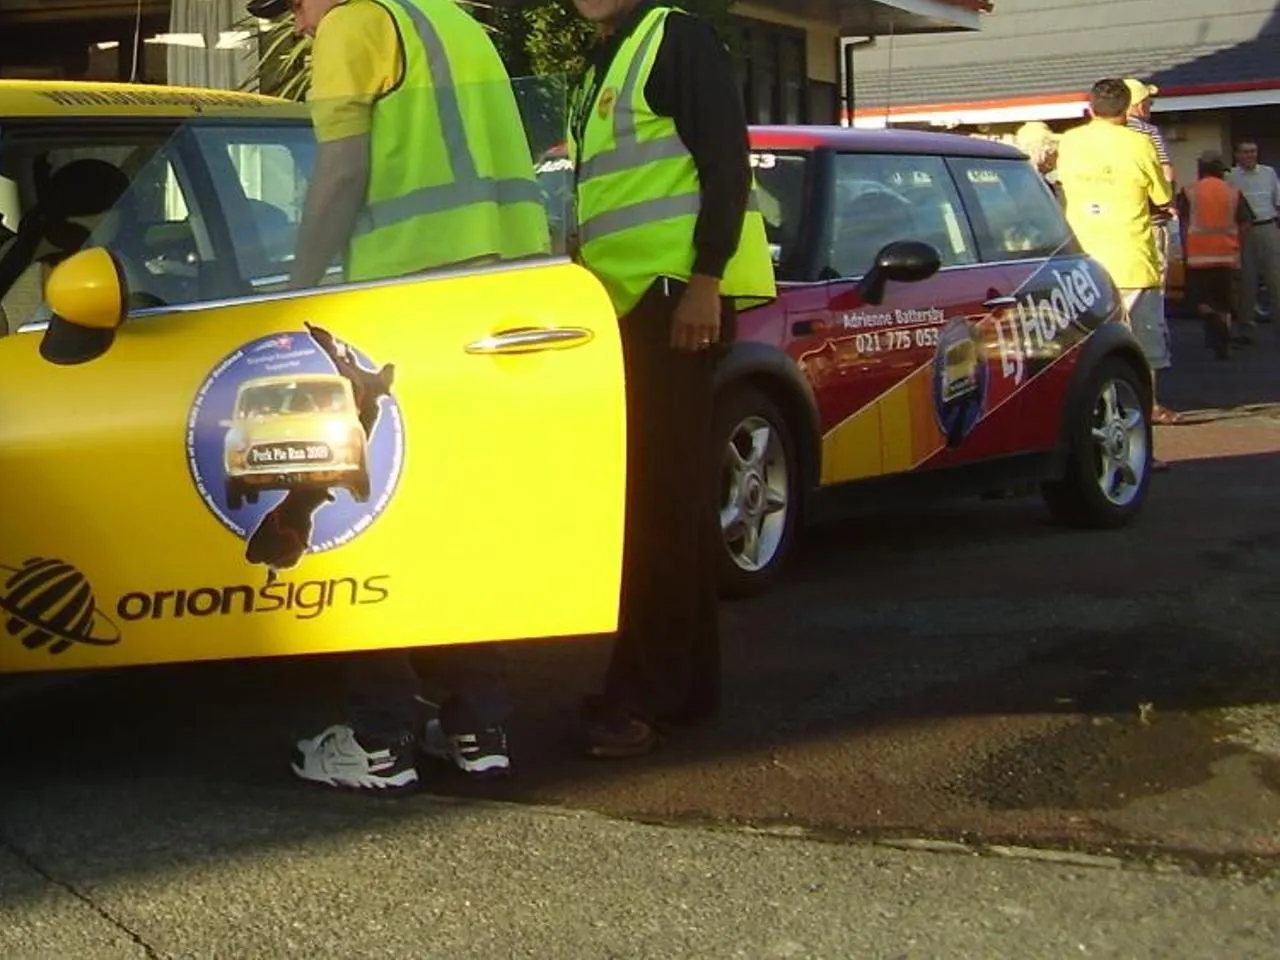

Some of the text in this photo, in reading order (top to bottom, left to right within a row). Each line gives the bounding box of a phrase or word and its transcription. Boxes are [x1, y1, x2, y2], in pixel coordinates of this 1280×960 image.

[856, 333, 881, 353] 021
[886, 330, 911, 351] 775
[118, 574, 390, 620] orionsigns
